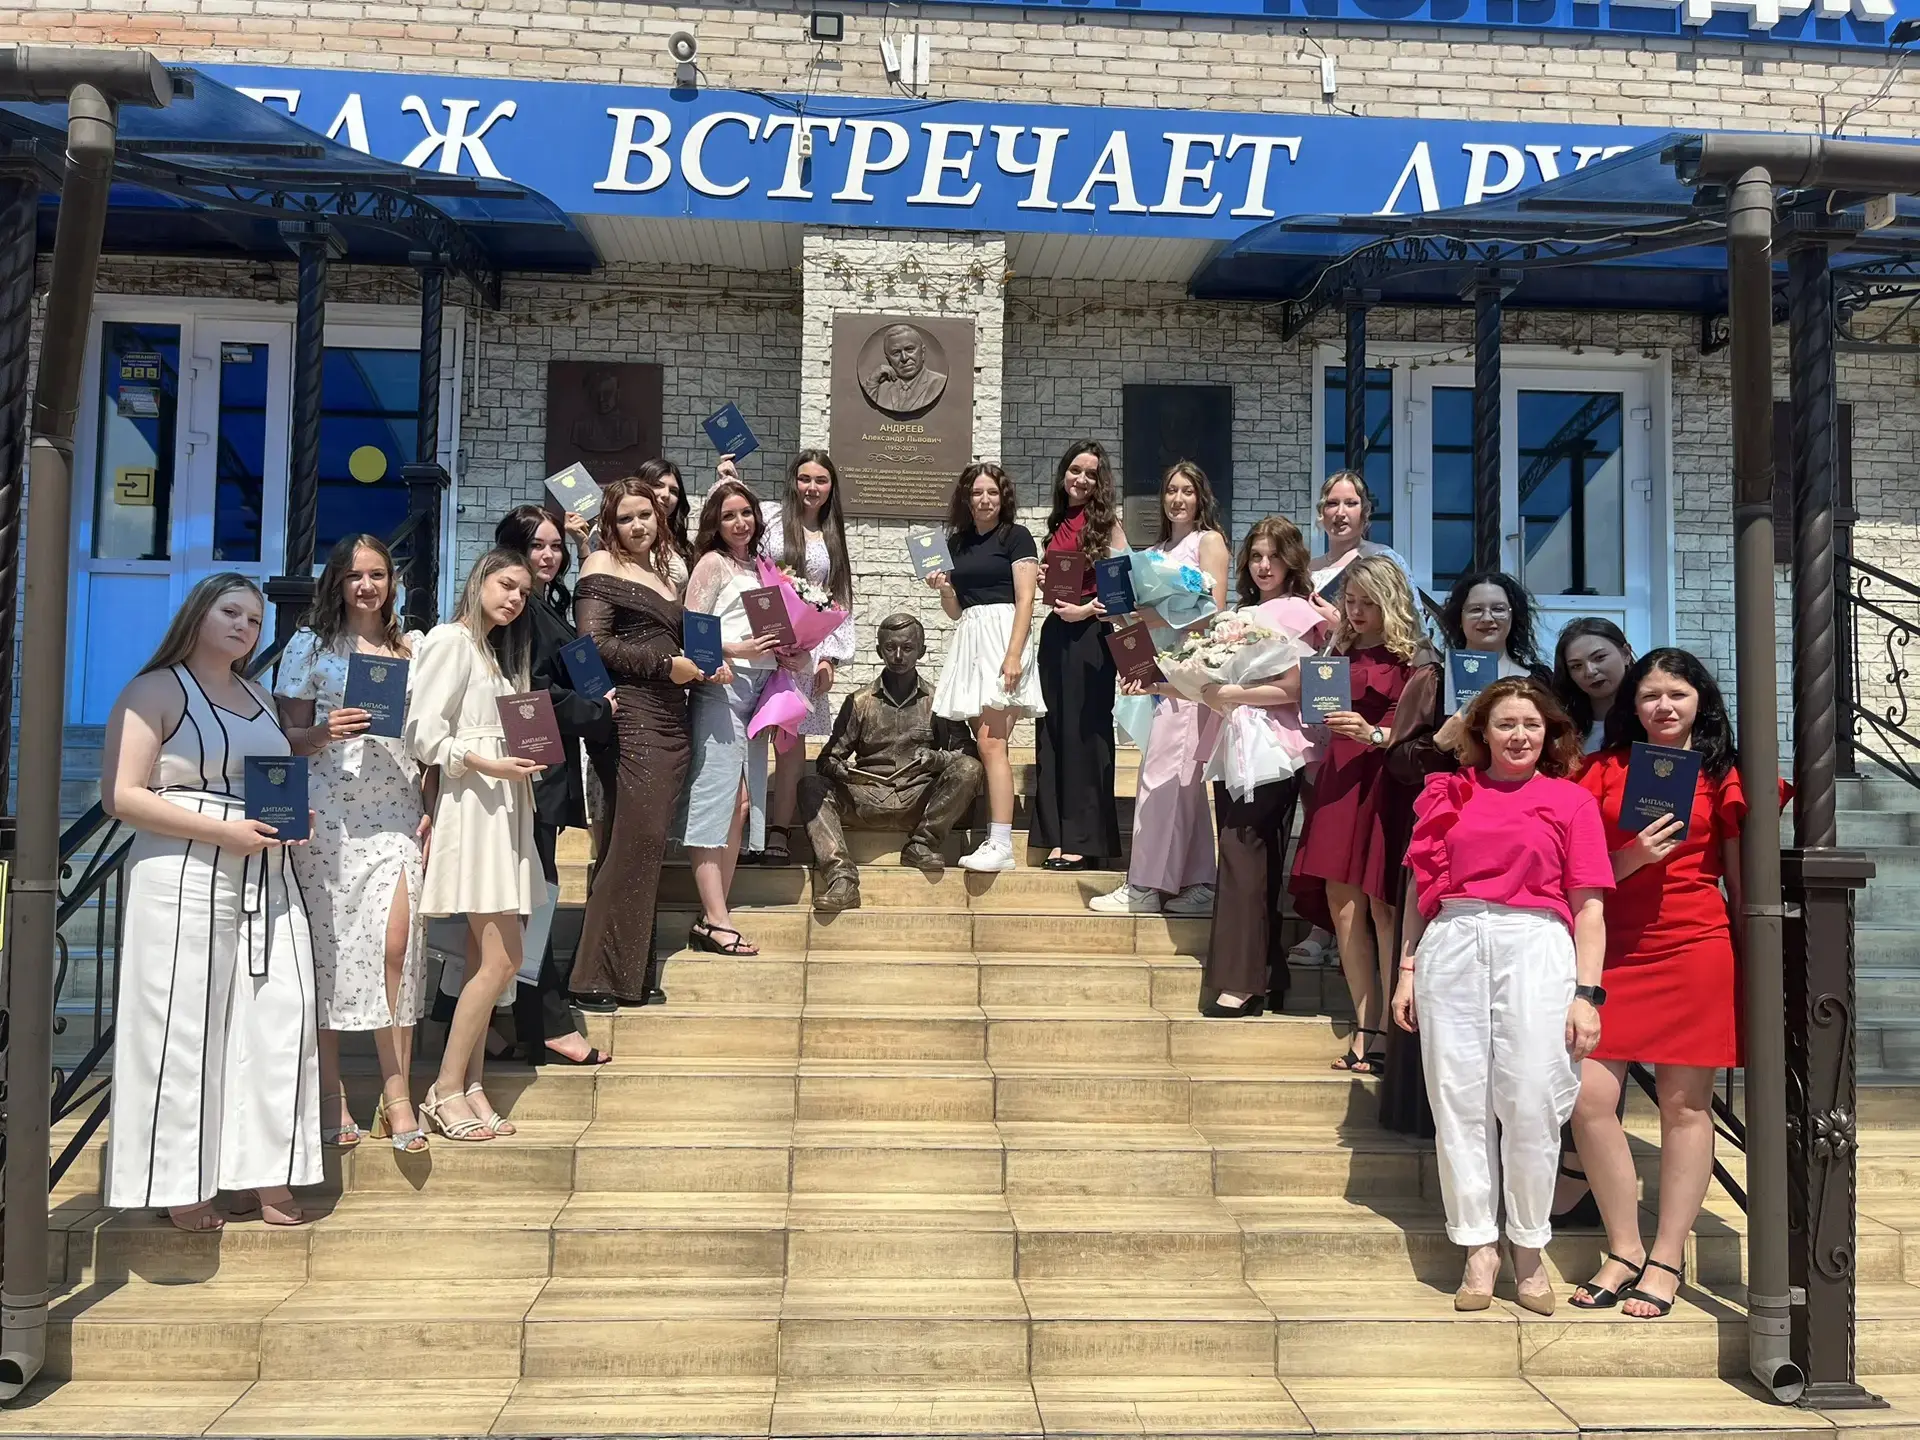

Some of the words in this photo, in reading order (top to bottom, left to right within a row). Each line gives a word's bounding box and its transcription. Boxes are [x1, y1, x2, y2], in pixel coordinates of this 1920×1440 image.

[593, 106, 1302, 218] ВСТРЕЧАЕТ
[1372, 140, 1634, 216] ДРУ
[880, 424, 924, 433] АНДРЕЕВ
[861, 433, 905, 443] Александр
[906, 435, 942, 443] Львович
[358, 701, 390, 710] ДИПЛОМ
[1637, 797, 1674, 809] ДИПЛОМ
